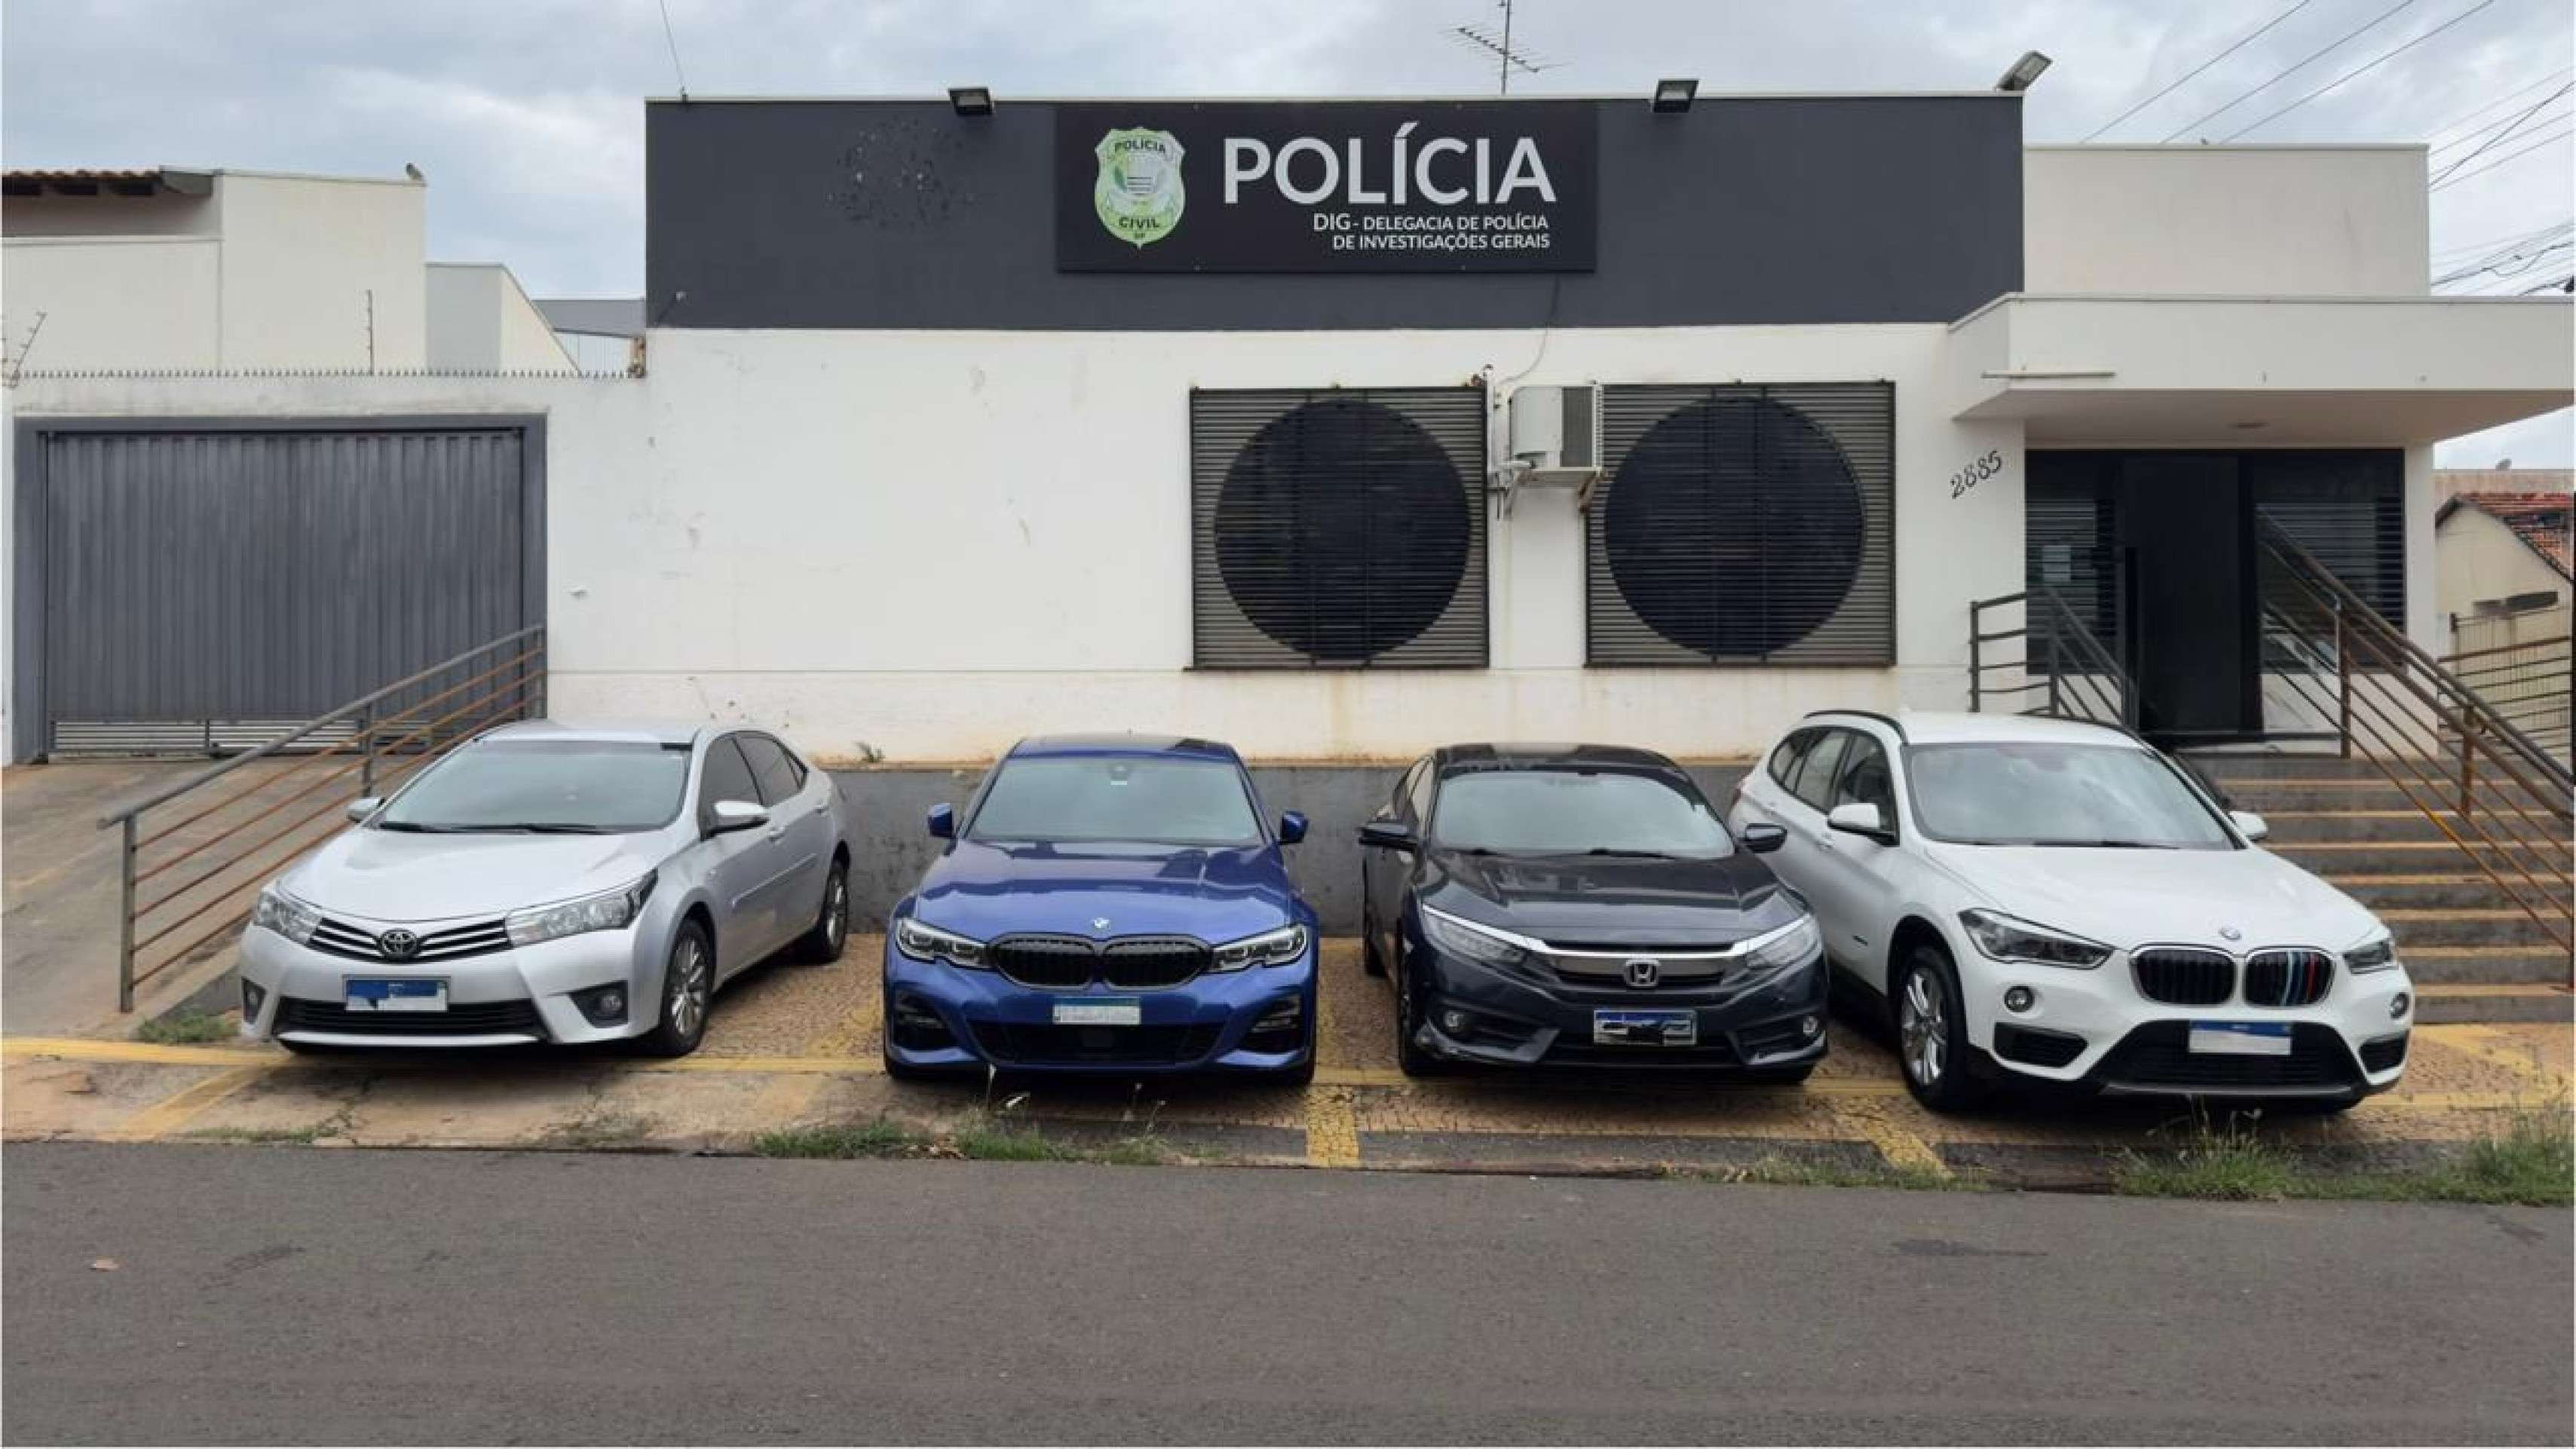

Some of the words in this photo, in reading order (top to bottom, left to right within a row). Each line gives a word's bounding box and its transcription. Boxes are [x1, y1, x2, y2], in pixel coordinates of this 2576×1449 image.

[1224, 121, 1557, 204] POLÍCIA
[1119, 216, 1160, 229] CIVIL
[1365, 216, 1453, 230] DELEGACIA
[1457, 216, 1480, 230] DE
[1483, 211, 1548, 230] POLÍCIA
[1333, 235, 1355, 250] DE
[1360, 232, 1487, 253] INVESTIGAÇÕES
[1492, 234, 1550, 249] GERAIS
[1950, 449, 2002, 499] 2885
